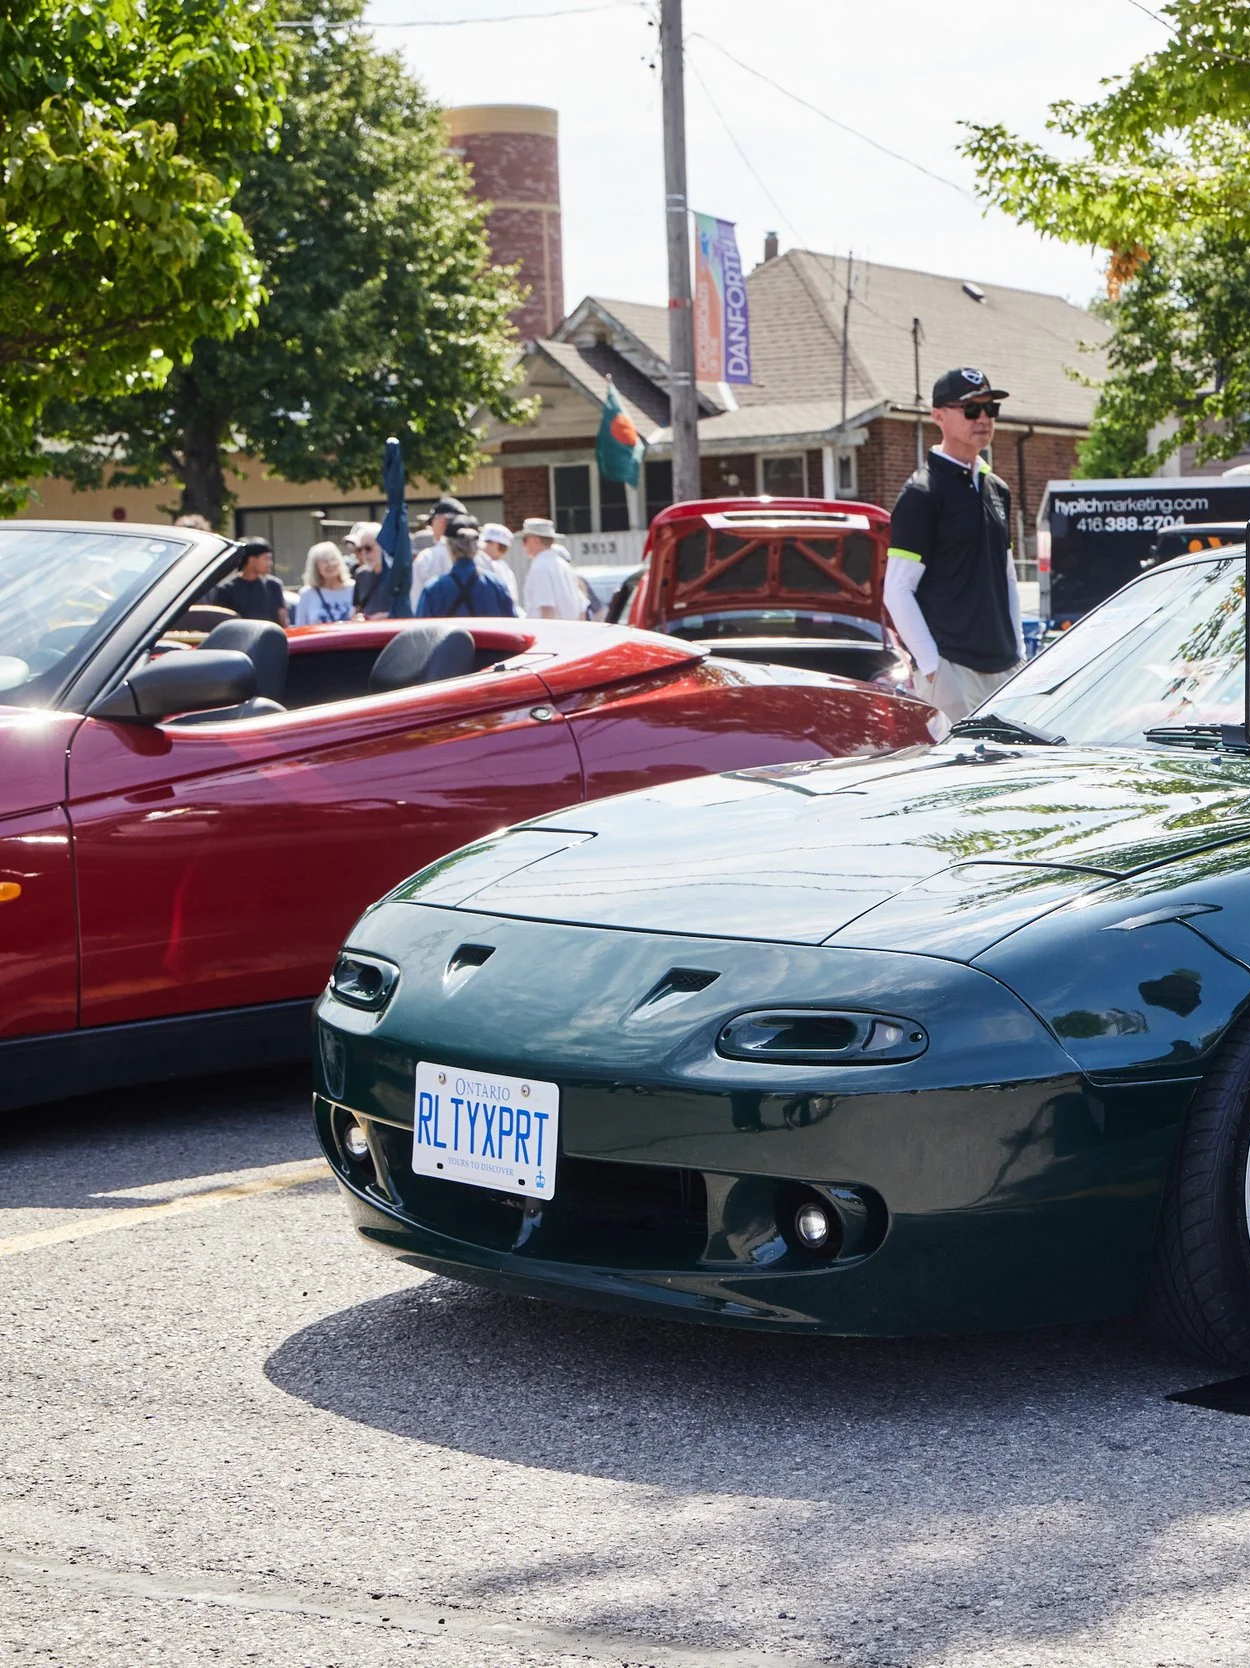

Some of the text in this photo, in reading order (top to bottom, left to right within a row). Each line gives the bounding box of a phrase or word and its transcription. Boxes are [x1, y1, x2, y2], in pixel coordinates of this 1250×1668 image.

[721, 238, 749, 378] DANFORTH
[456, 1078, 511, 1101] ONTARIO
[418, 1092, 549, 1167] RLTYXPRT
[448, 1156, 514, 1177] YOURS TO DISCOVER
